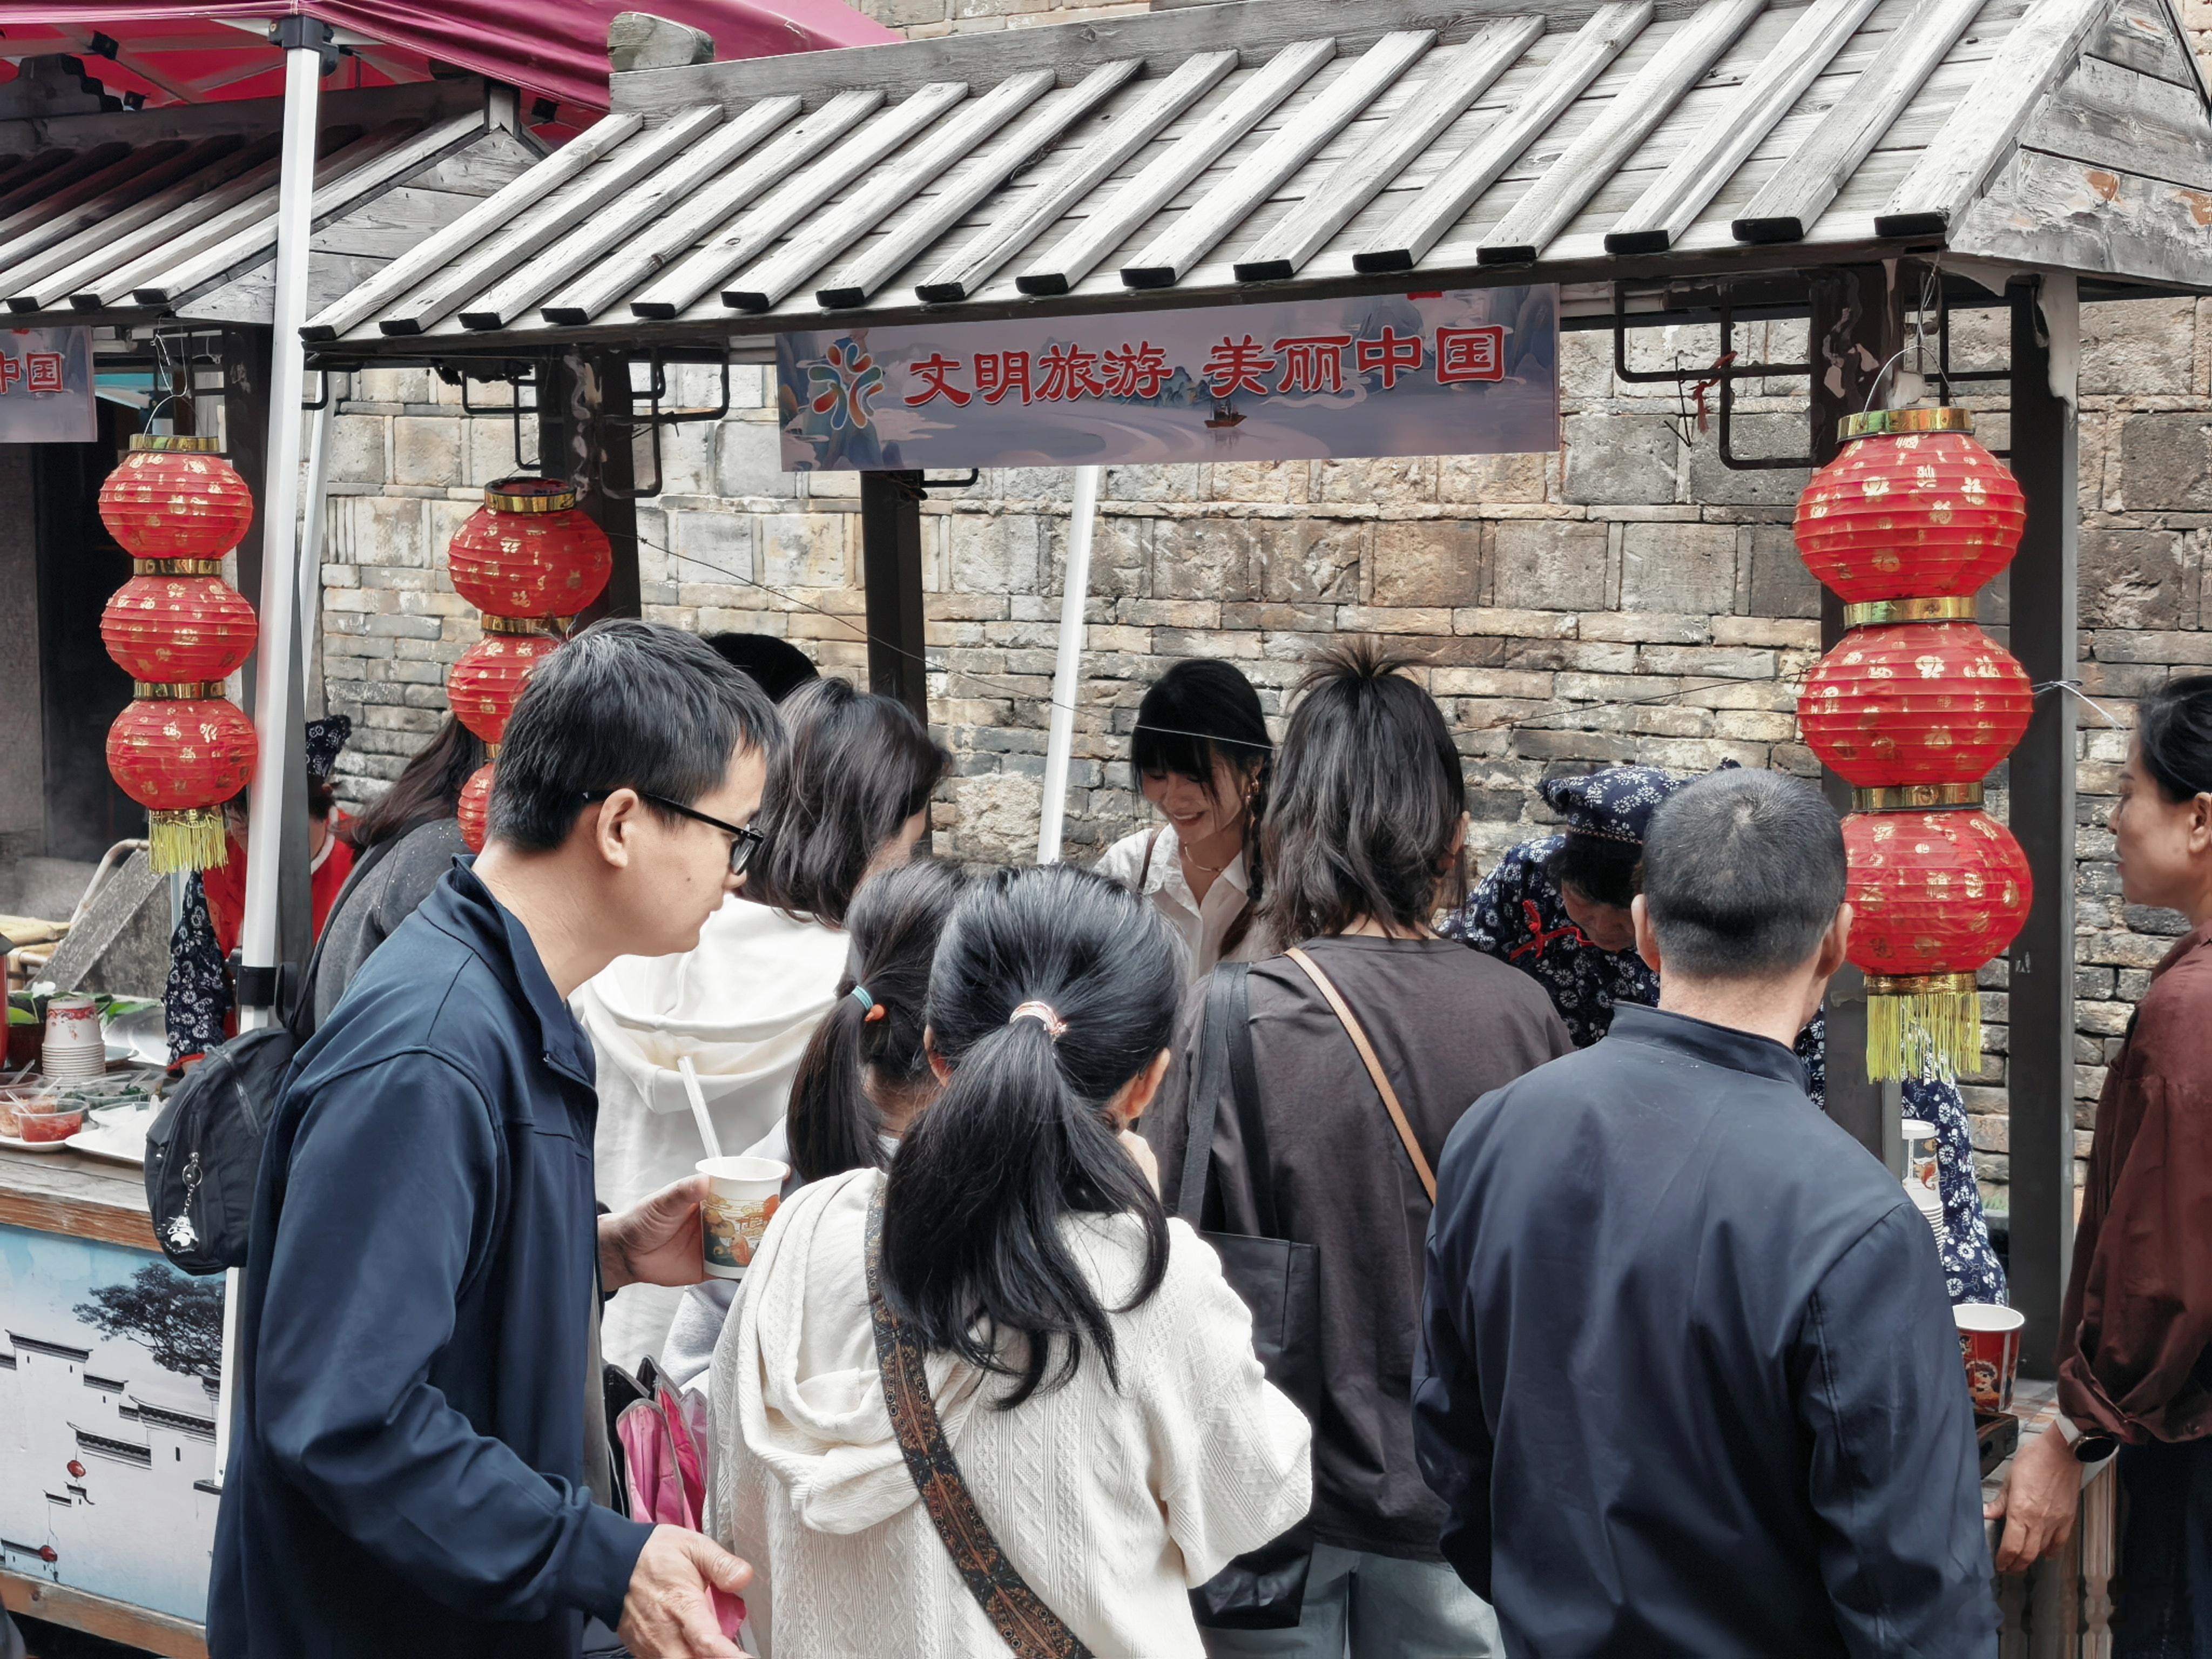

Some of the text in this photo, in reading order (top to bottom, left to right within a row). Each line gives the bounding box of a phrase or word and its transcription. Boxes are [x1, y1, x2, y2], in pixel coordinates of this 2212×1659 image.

[904, 325, 1506, 406] 文明旅游 美丽中国
